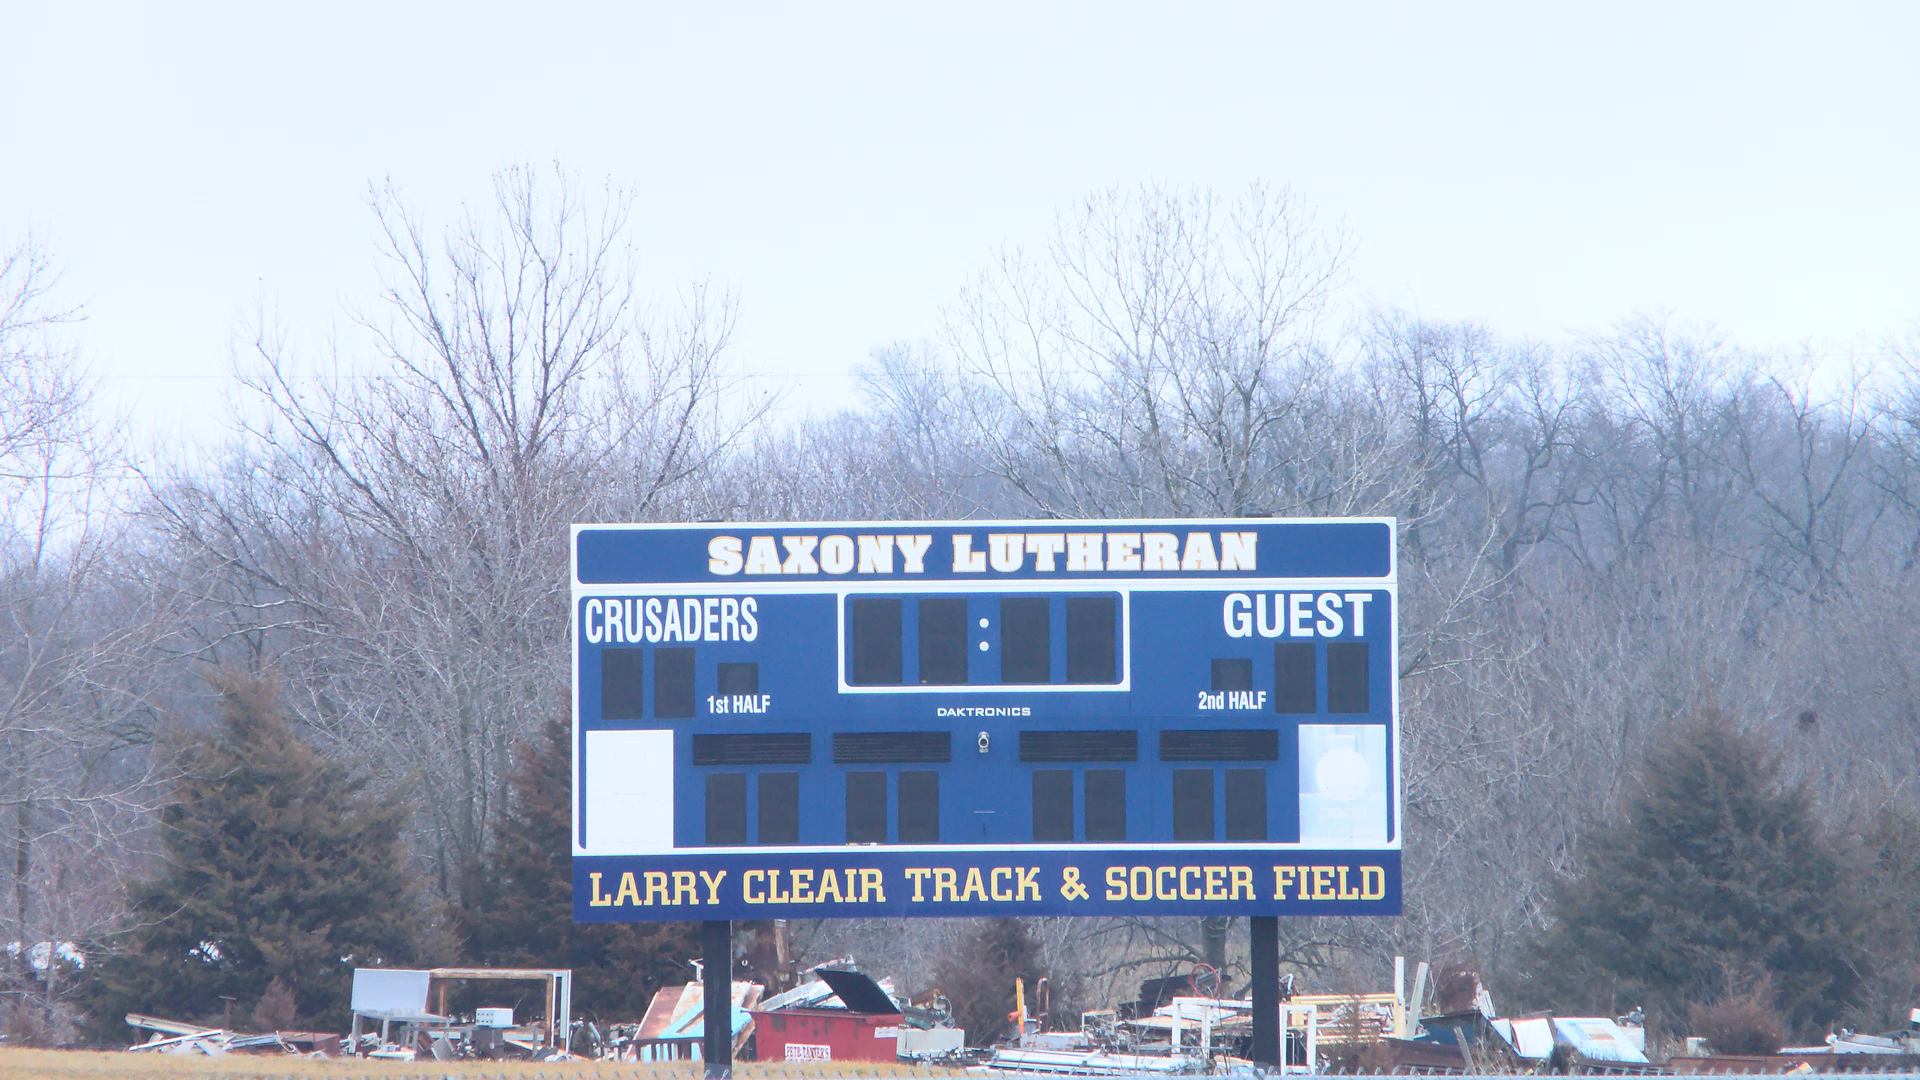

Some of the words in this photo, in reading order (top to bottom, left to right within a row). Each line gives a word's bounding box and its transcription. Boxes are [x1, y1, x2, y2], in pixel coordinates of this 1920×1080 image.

[707, 534, 933, 576] SAXONY
[951, 531, 1258, 573] LUTHERAN
[585, 596, 759, 644] CRUSADERS
[1223, 592, 1373, 638] GUEST
[706, 695, 730, 714] 1st
[732, 694, 771, 714] HALF
[937, 707, 1031, 717] DAKTRONICS
[1198, 690, 1226, 711] 2nd
[1228, 690, 1267, 711] HALF
[589, 869, 727, 907] LARRY
[743, 867, 886, 904] CLEAIR
[904, 866, 1042, 902] TRACK
[1059, 866, 1090, 901] &
[1105, 865, 1257, 901] SOCCER
[1272, 865, 1386, 900] FIELD
